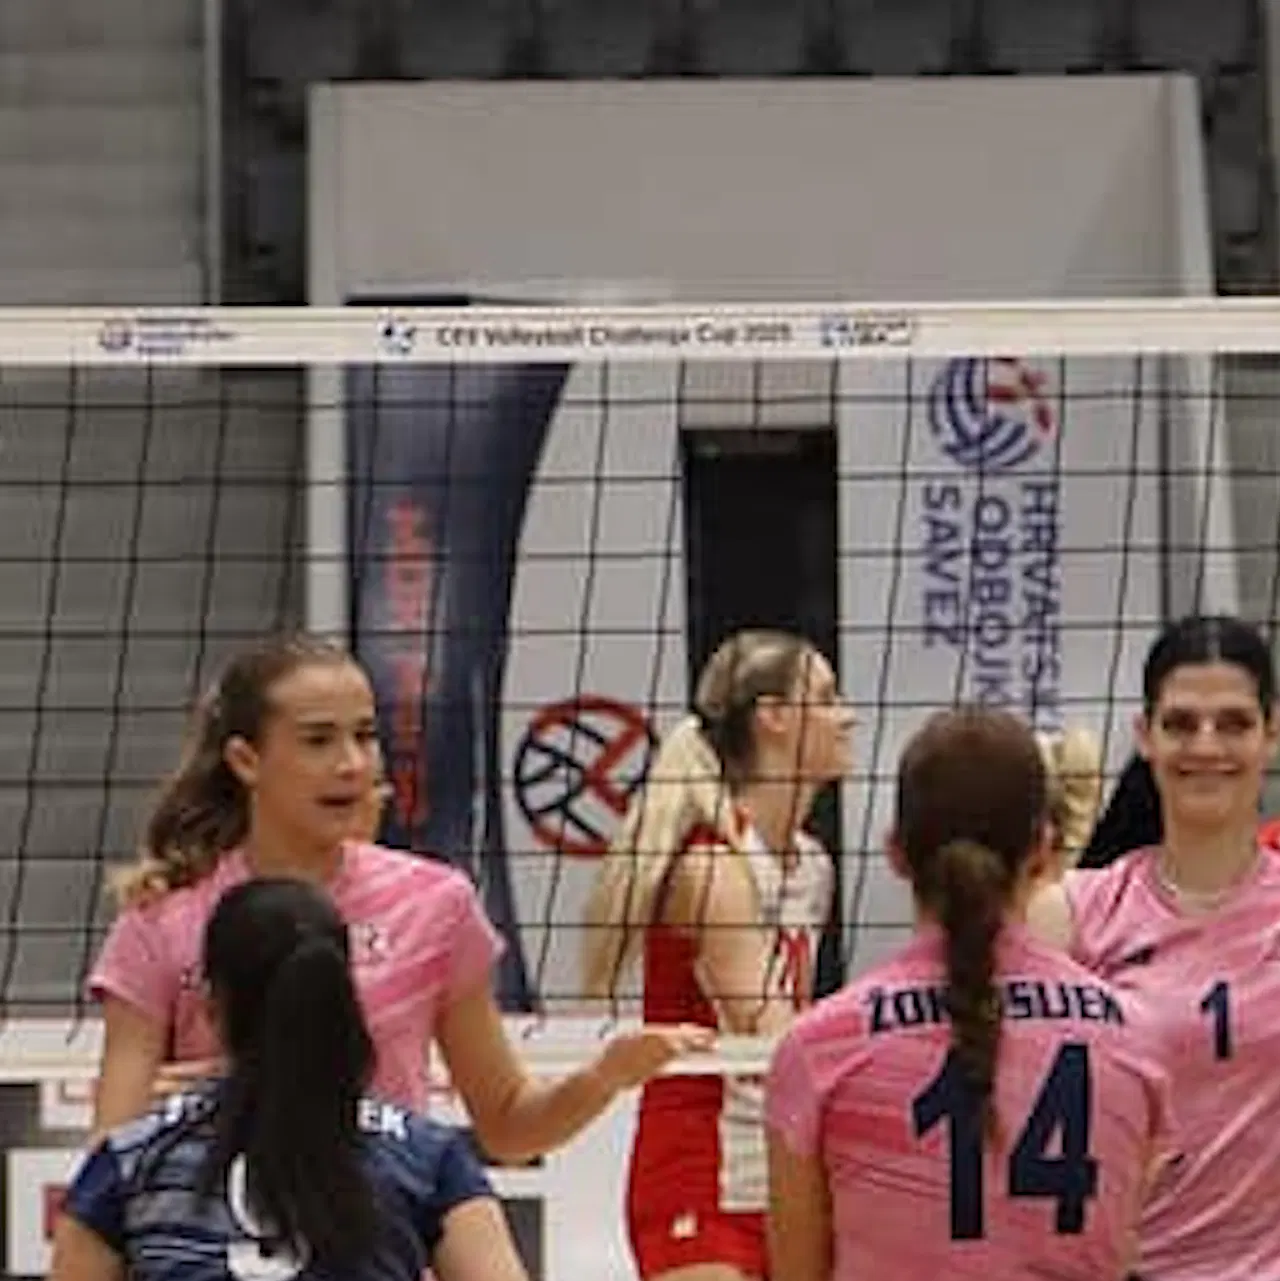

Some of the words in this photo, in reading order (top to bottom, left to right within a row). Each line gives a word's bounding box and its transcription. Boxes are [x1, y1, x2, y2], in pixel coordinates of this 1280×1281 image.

[923, 485, 963, 648] SAVEZ
[972, 496, 1011, 706] ODBOJK
[1004, 980, 1125, 1026] SIJEK
[1200, 981, 1230, 1061] 1
[913, 1044, 1099, 1239] 14
